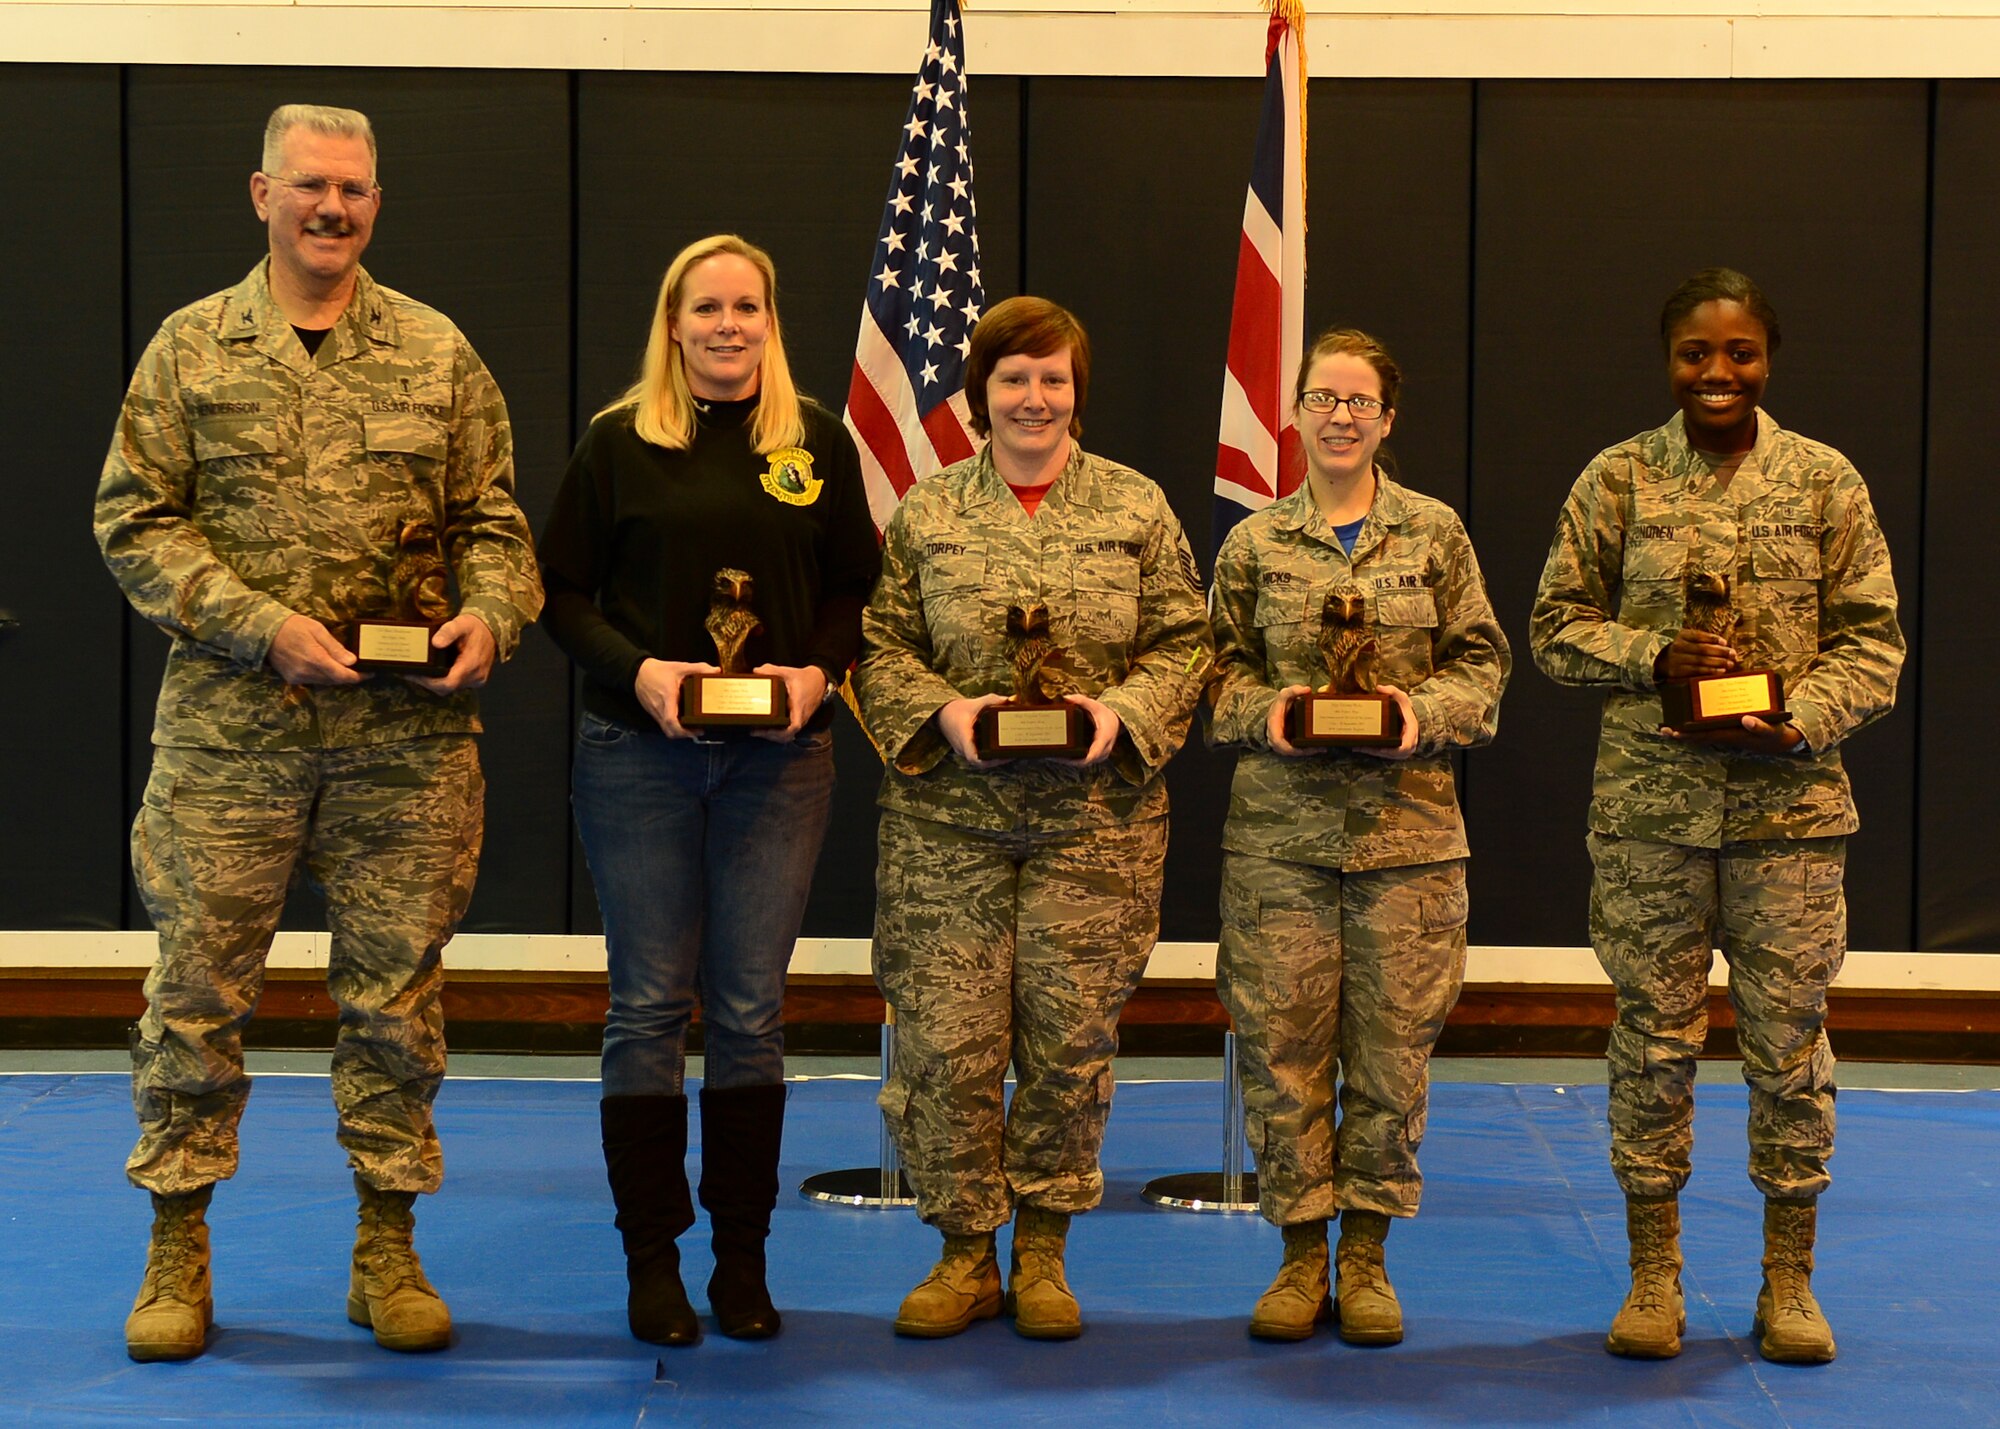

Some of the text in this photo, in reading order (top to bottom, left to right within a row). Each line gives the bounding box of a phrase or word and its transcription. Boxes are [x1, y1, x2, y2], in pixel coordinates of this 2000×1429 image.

[1774, 524, 1792, 538] AIR
[926, 542, 967, 556] TORPEY
[1097, 540, 1116, 553] AIR
[1398, 575, 1417, 588] AIR
